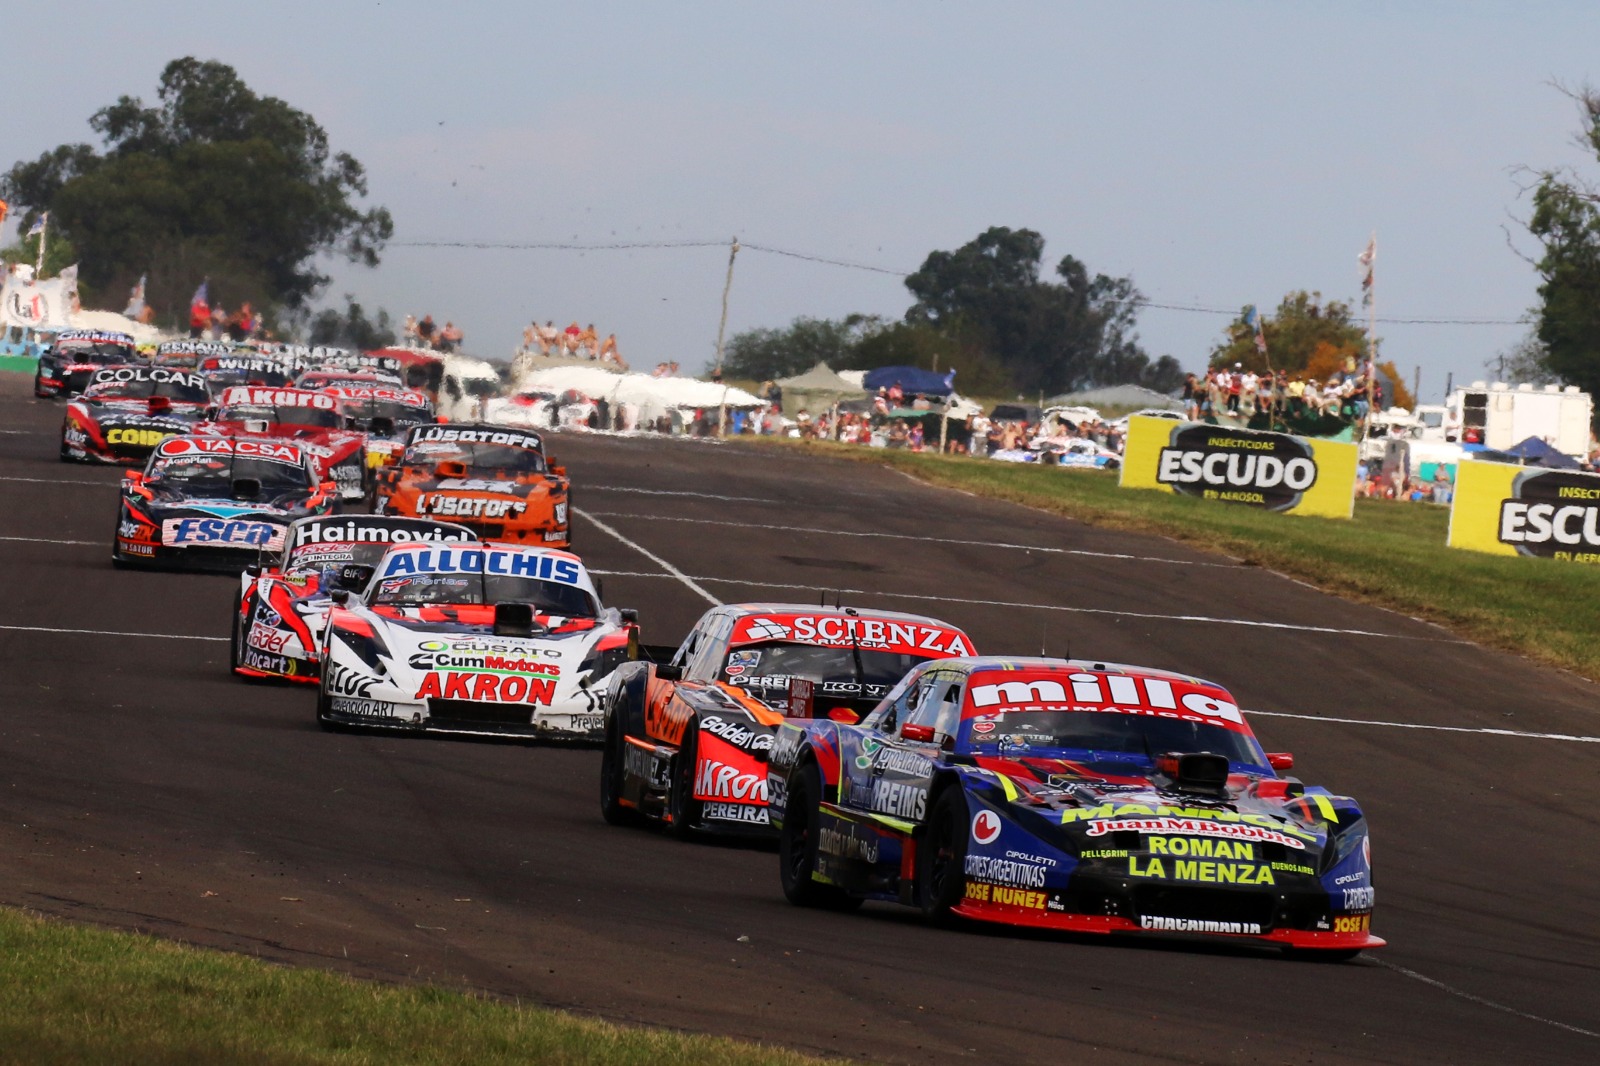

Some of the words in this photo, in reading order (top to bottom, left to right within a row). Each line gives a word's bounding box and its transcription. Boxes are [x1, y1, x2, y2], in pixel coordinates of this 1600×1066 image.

[95, 368, 205, 391] COLCAR
[201, 440, 295, 462] TACSA
[1207, 437, 1275, 451] INSECTICIDAS
[1158, 449, 1316, 491] ESCUDO
[1220, 492, 1265, 504] AEROSOL
[384, 550, 579, 585] ALLOCHIS
[794, 617, 970, 657] SCIENZA
[452, 643, 563, 659] CUSATO
[415, 672, 557, 706] AKRON
[970, 673, 1244, 725] milla
[371, 701, 396, 718] ART
[700, 716, 755, 749] Golden
[702, 802, 769, 823] PEREIRA
[1061, 802, 1317, 842] MANNOL
[1005, 850, 1057, 867] CIPOLLETTI
[1081, 849, 1128, 859] PELLEGRINI
[1148, 836, 1254, 861] ROMAN
[987, 858, 1047, 888] ARGENTINAS
[1129, 856, 1166, 879] LA
[1175, 859, 1275, 886] MENZA
[965, 881, 990, 901] JOSE
[992, 885, 1047, 910] NUÑEZ
[1334, 916, 1361, 933] JOSE
